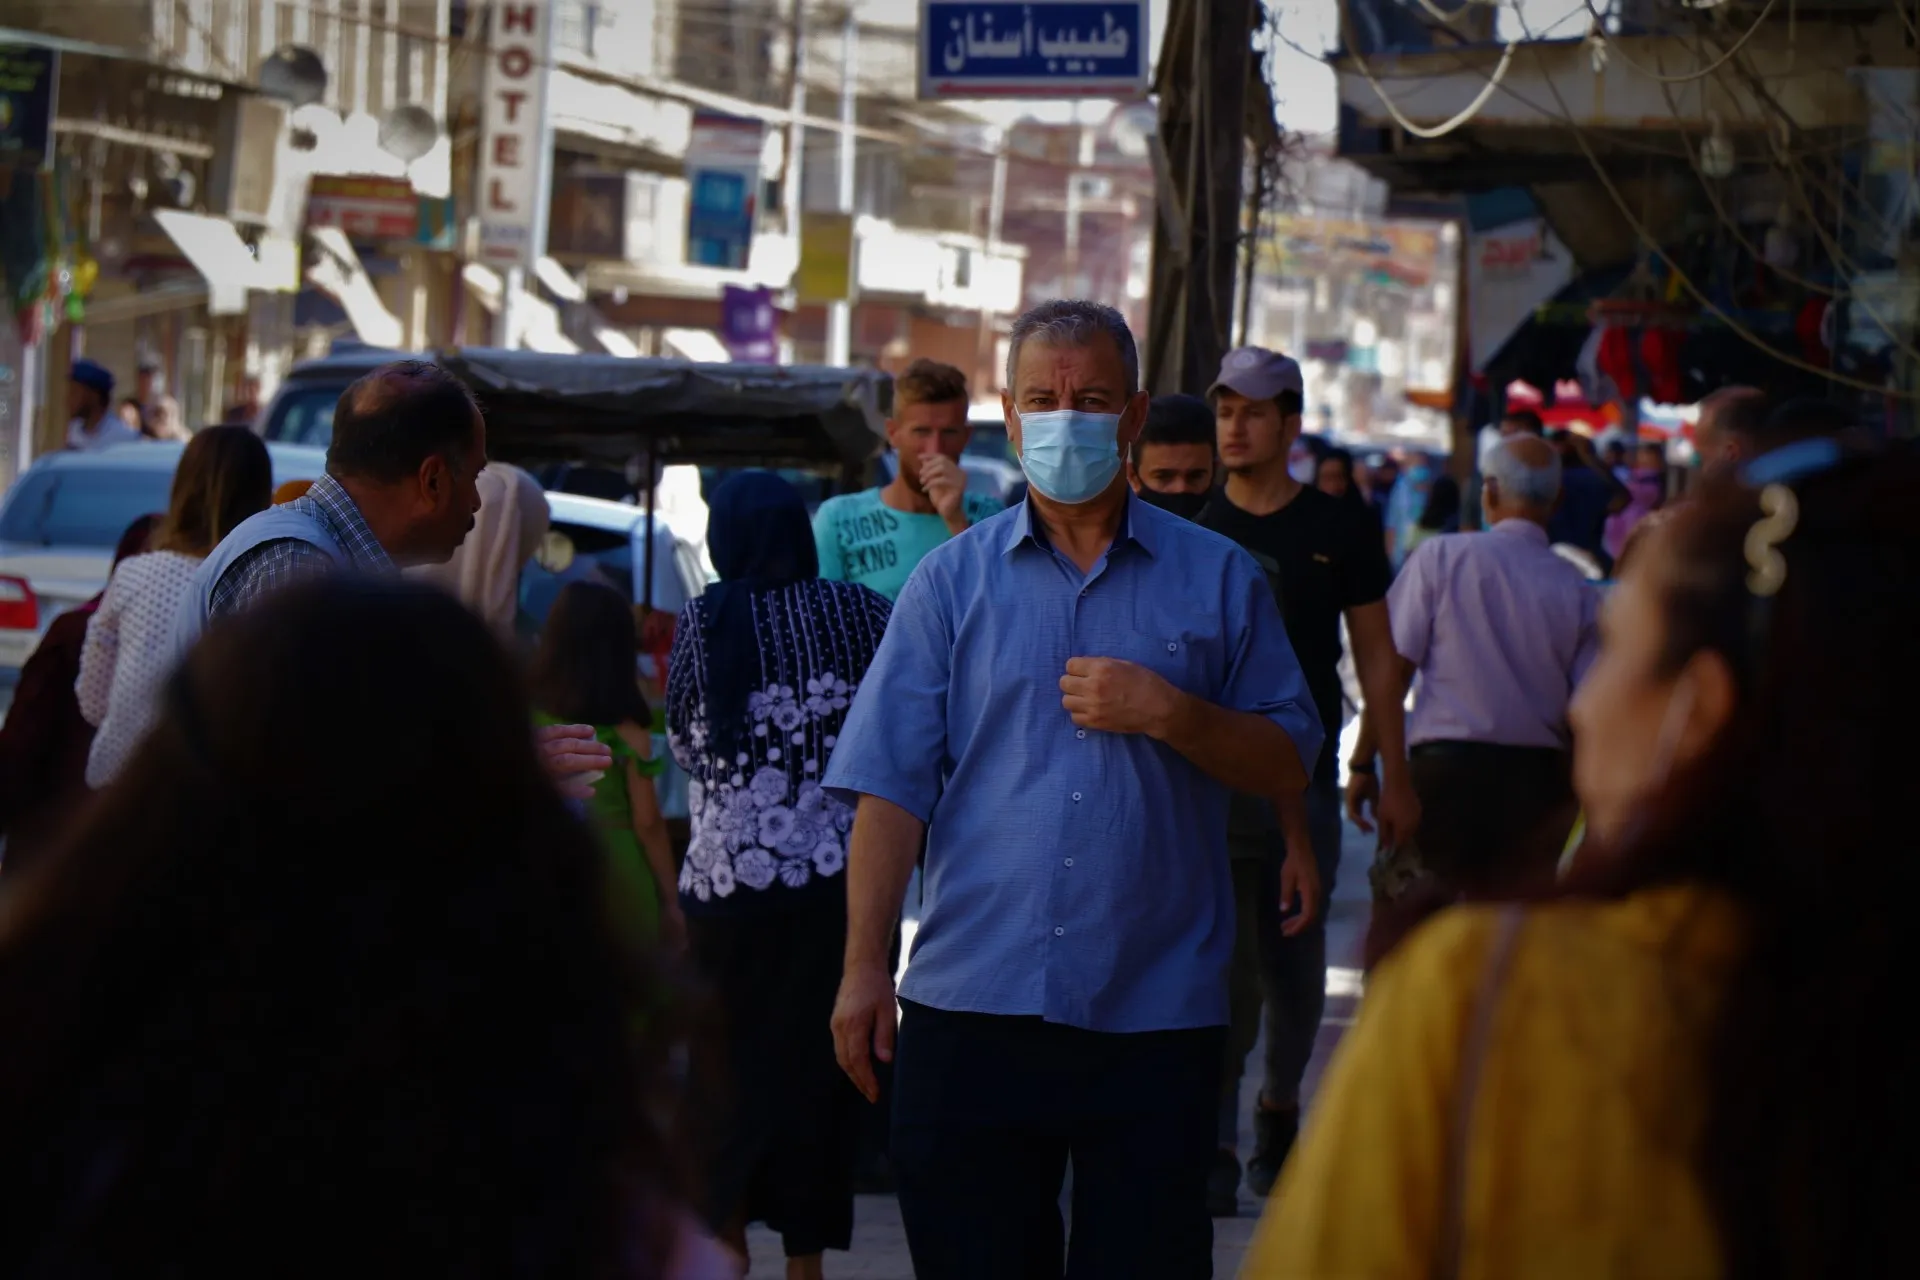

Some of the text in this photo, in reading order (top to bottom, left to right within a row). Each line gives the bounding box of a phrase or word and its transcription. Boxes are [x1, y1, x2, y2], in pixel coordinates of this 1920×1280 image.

[943, 4, 1130, 73] طبيب أسنان
[489, 4, 535, 213] HOTEL
[836, 508, 899, 546] SIGNS
